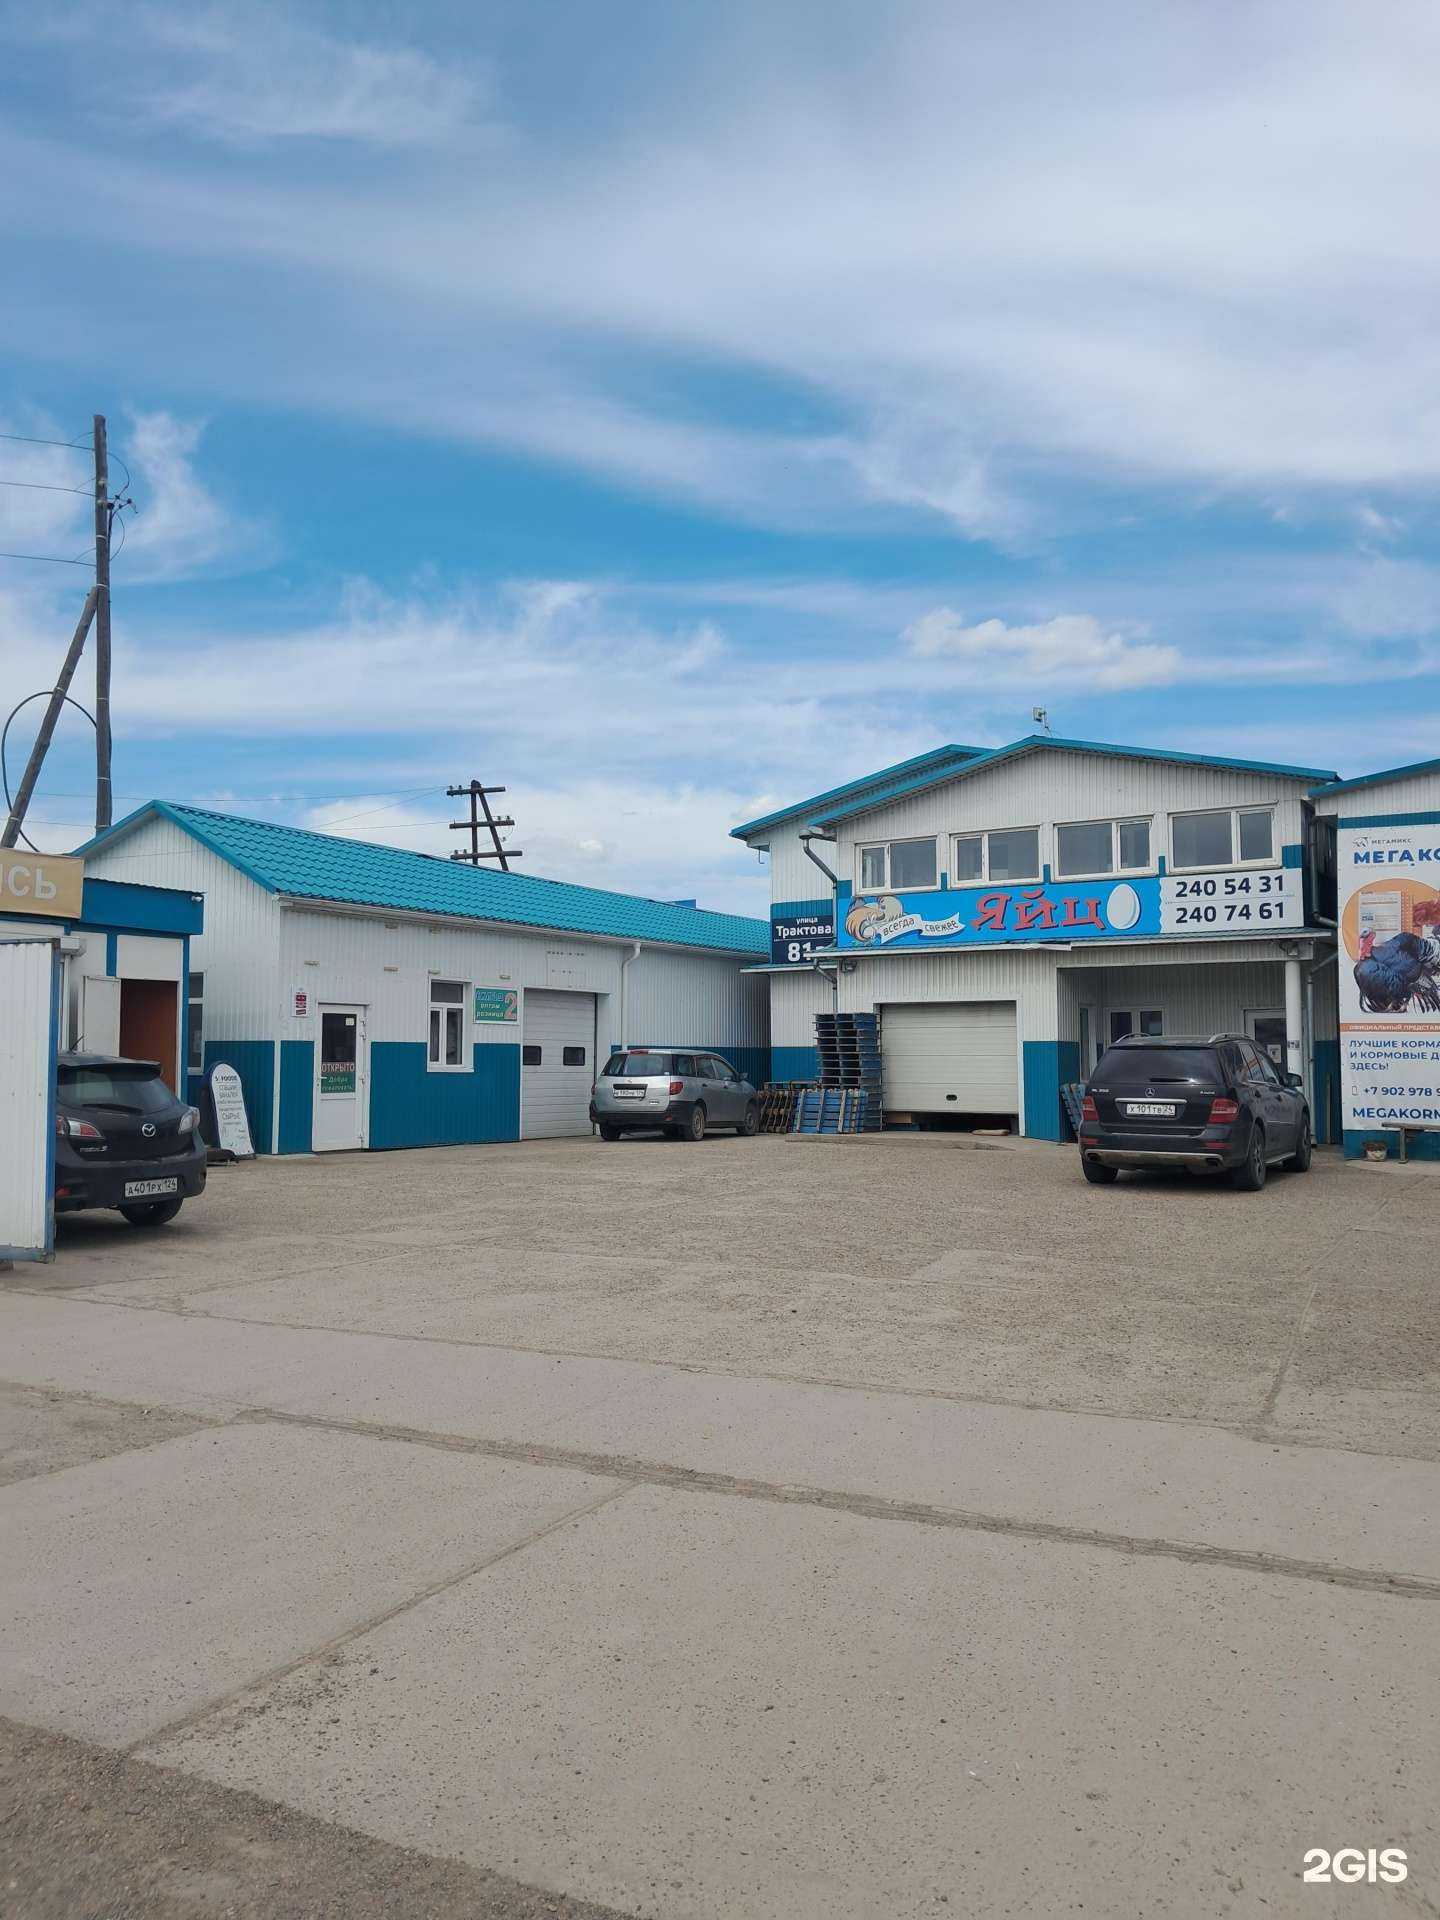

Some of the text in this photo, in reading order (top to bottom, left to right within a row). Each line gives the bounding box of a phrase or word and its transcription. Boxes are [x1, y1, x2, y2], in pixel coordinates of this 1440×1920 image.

[0, 864, 57, 900] СЬ
[1175, 874, 1283, 898] 240 54 31
[1175, 901, 1284, 924] 240 74 61
[796, 916, 818, 925] улица
[775, 924, 833, 939] Трактова
[883, 917, 915, 937] всегда
[503, 991, 518, 1020] 2
[1349, 1040, 1398, 1048] ЛУЧШИЕ
[1350, 1051, 1440, 1061] И КОРМОВЫЕ Д
[321, 1063, 355, 1073] ОТКРЫТО
[1351, 1062, 1389, 1071] ЗДЕСЬ!
[1364, 1086, 1378, 1096] +7
[1381, 1086, 1405, 1096] 902
[1408, 1087, 1432, 1096] 978
